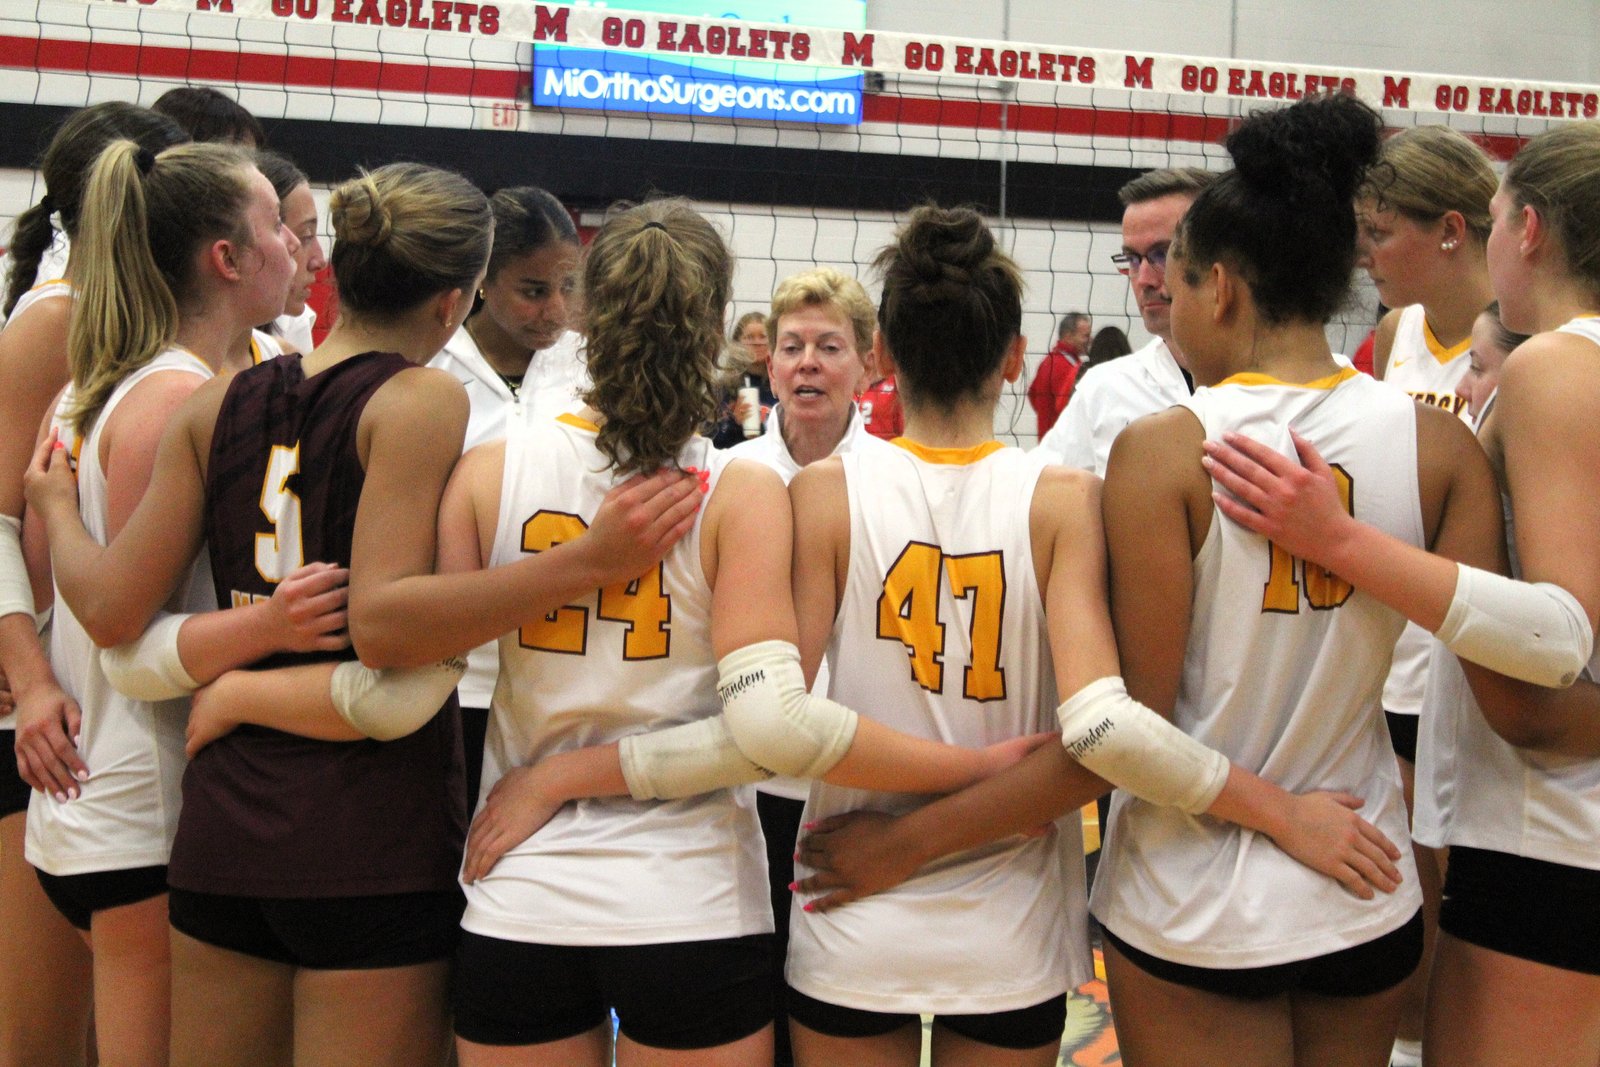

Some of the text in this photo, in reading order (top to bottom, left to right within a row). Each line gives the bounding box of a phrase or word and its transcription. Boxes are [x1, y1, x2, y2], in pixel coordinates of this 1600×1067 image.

[330, 0, 501, 36] EAGLETS
[533, 5, 570, 42] M
[601, 16, 811, 62] GO EAGLETS
[841, 31, 875, 67] M
[904, 41, 1096, 84] GO EAGLETS
[1123, 55, 1154, 90] M
[1180, 64, 1218, 93] GO
[543, 68, 856, 115] MiOrthoSurgeons.com
[1382, 76, 1411, 109] M
[1434, 84, 1599, 119] GO EAGLETS
[254, 439, 305, 584] 5
[518, 508, 672, 662] 24
[875, 539, 1007, 703] 47
[718, 669, 766, 708] Tandem
[1065, 716, 1115, 759] Tandem
